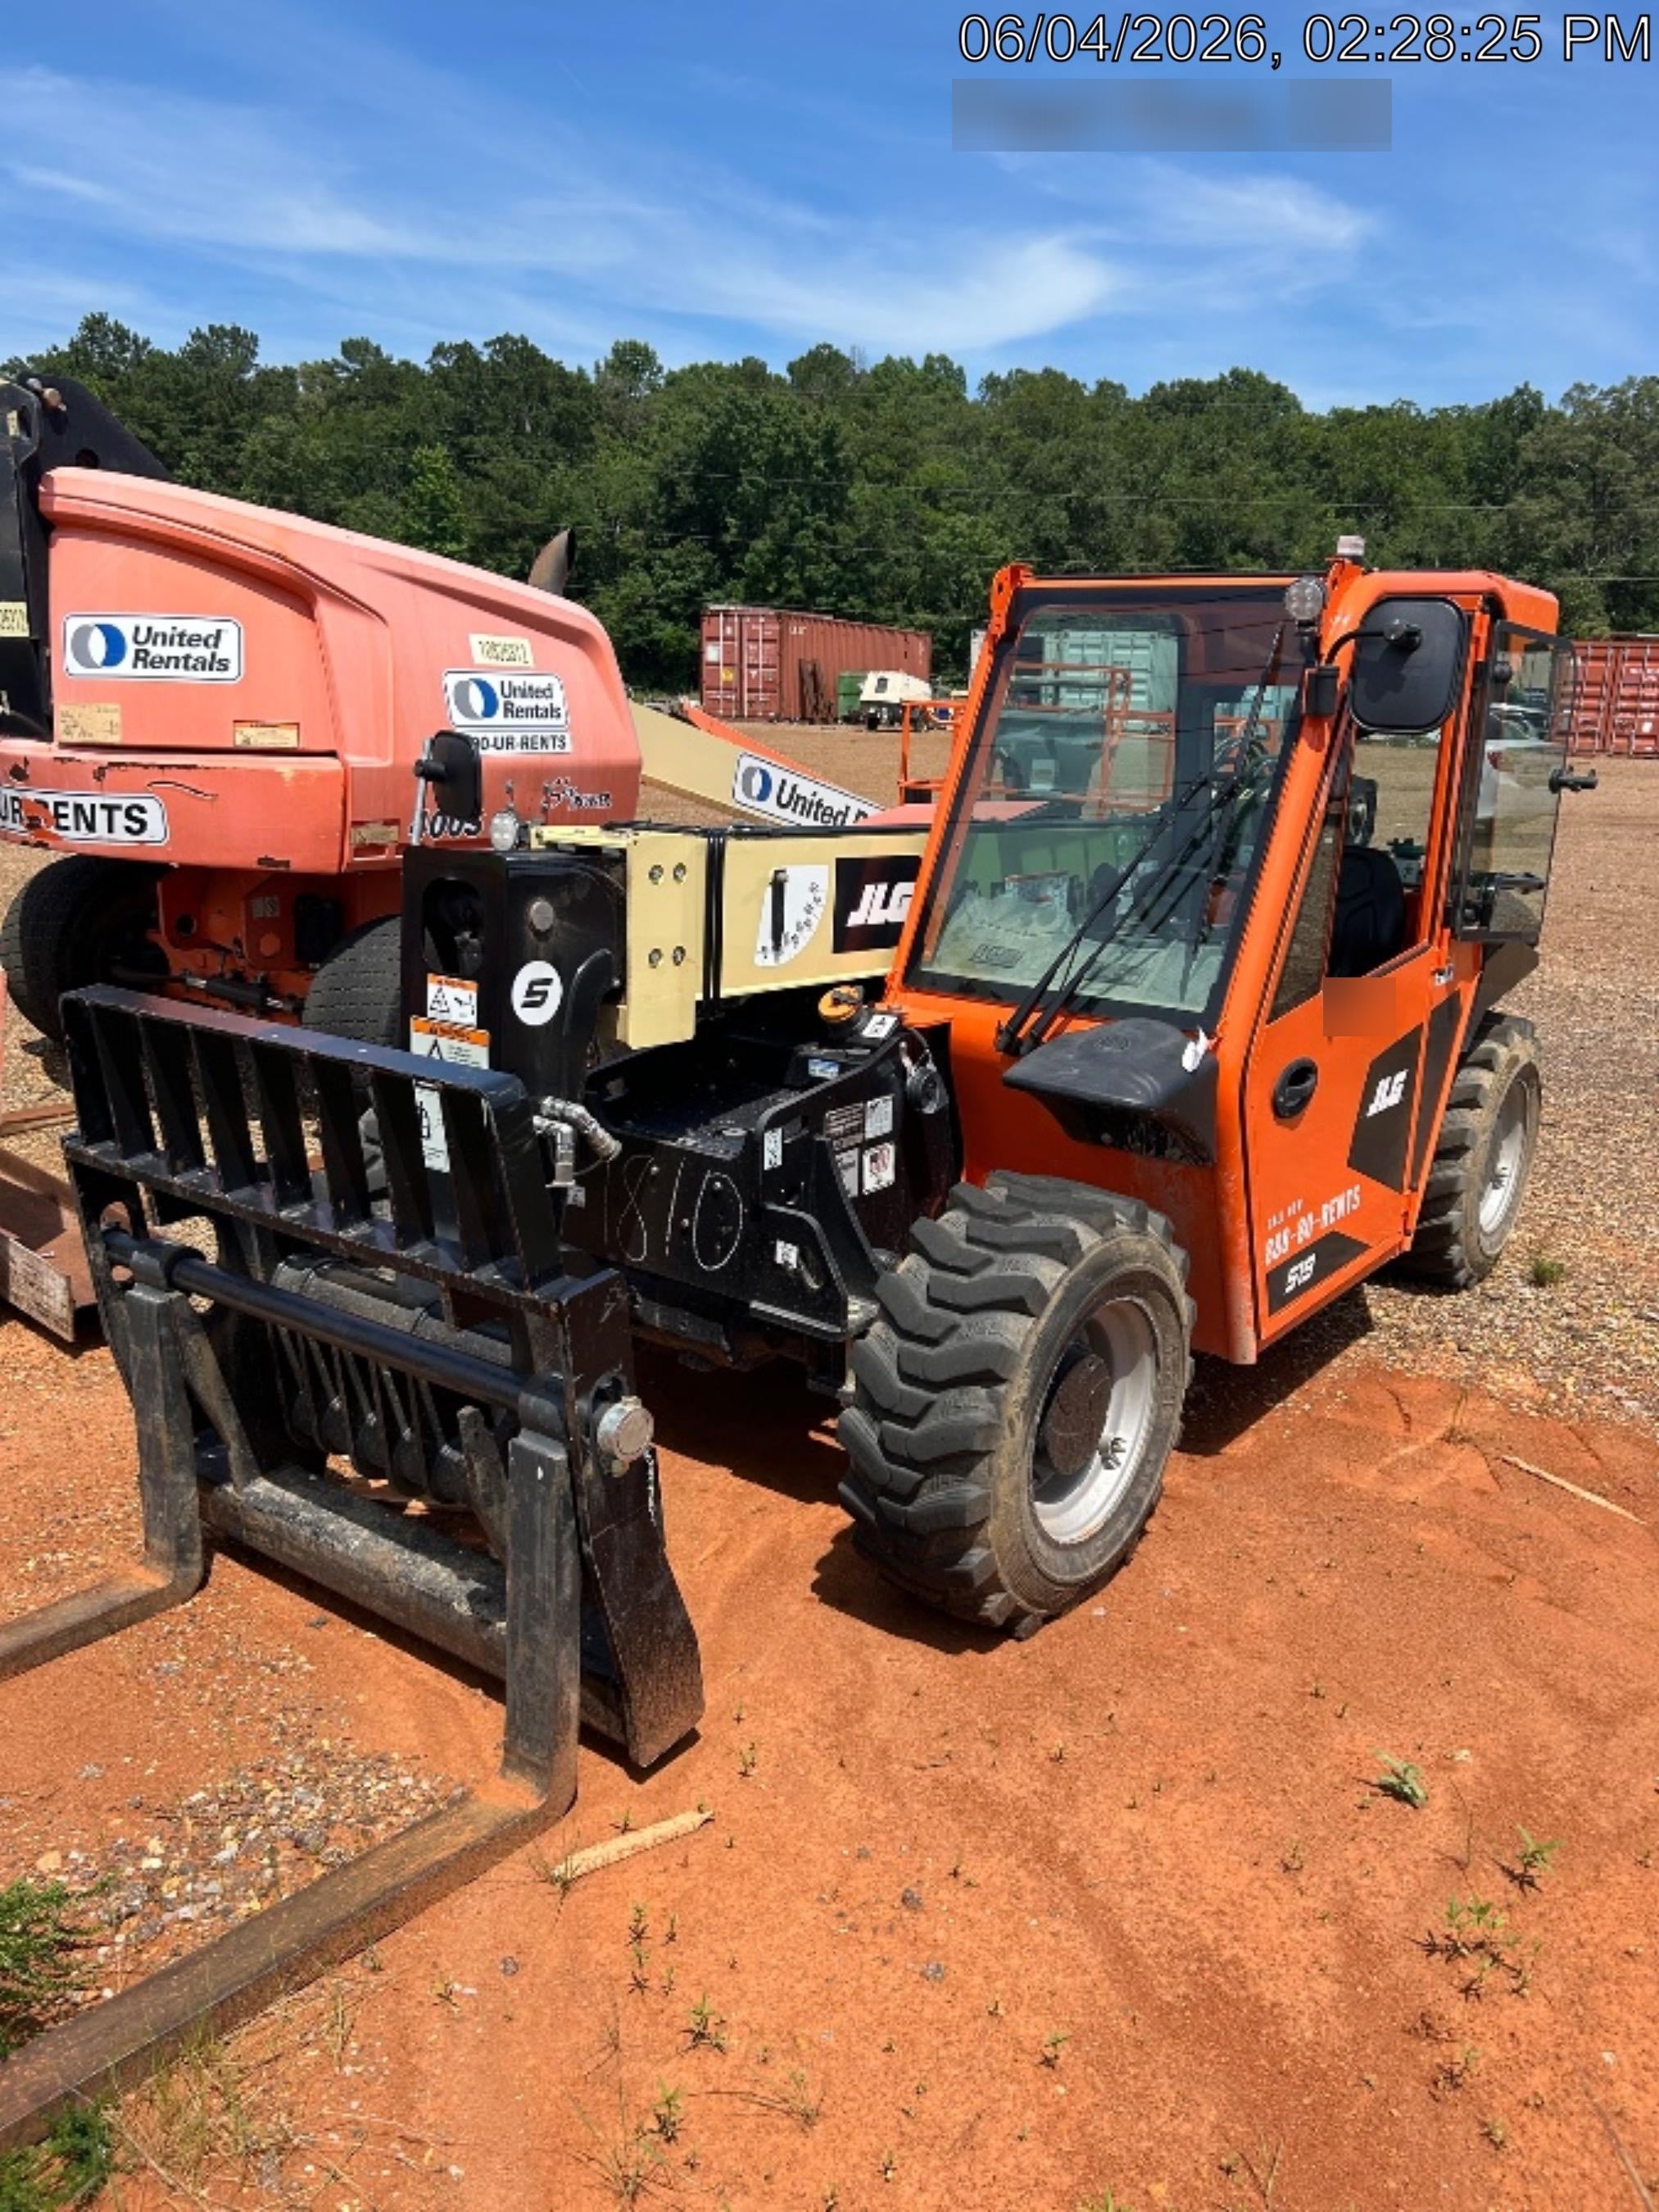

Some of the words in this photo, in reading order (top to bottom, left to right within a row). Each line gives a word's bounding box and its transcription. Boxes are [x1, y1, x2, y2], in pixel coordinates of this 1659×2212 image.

[132, 625, 223, 650] United
[132, 648, 230, 672] Rentals
[500, 679, 555, 700] United
[502, 700, 562, 719] Rentals
[776, 778, 851, 826] United
[845, 882, 916, 927] JLG
[1366, 1068, 1409, 1117] JLG
